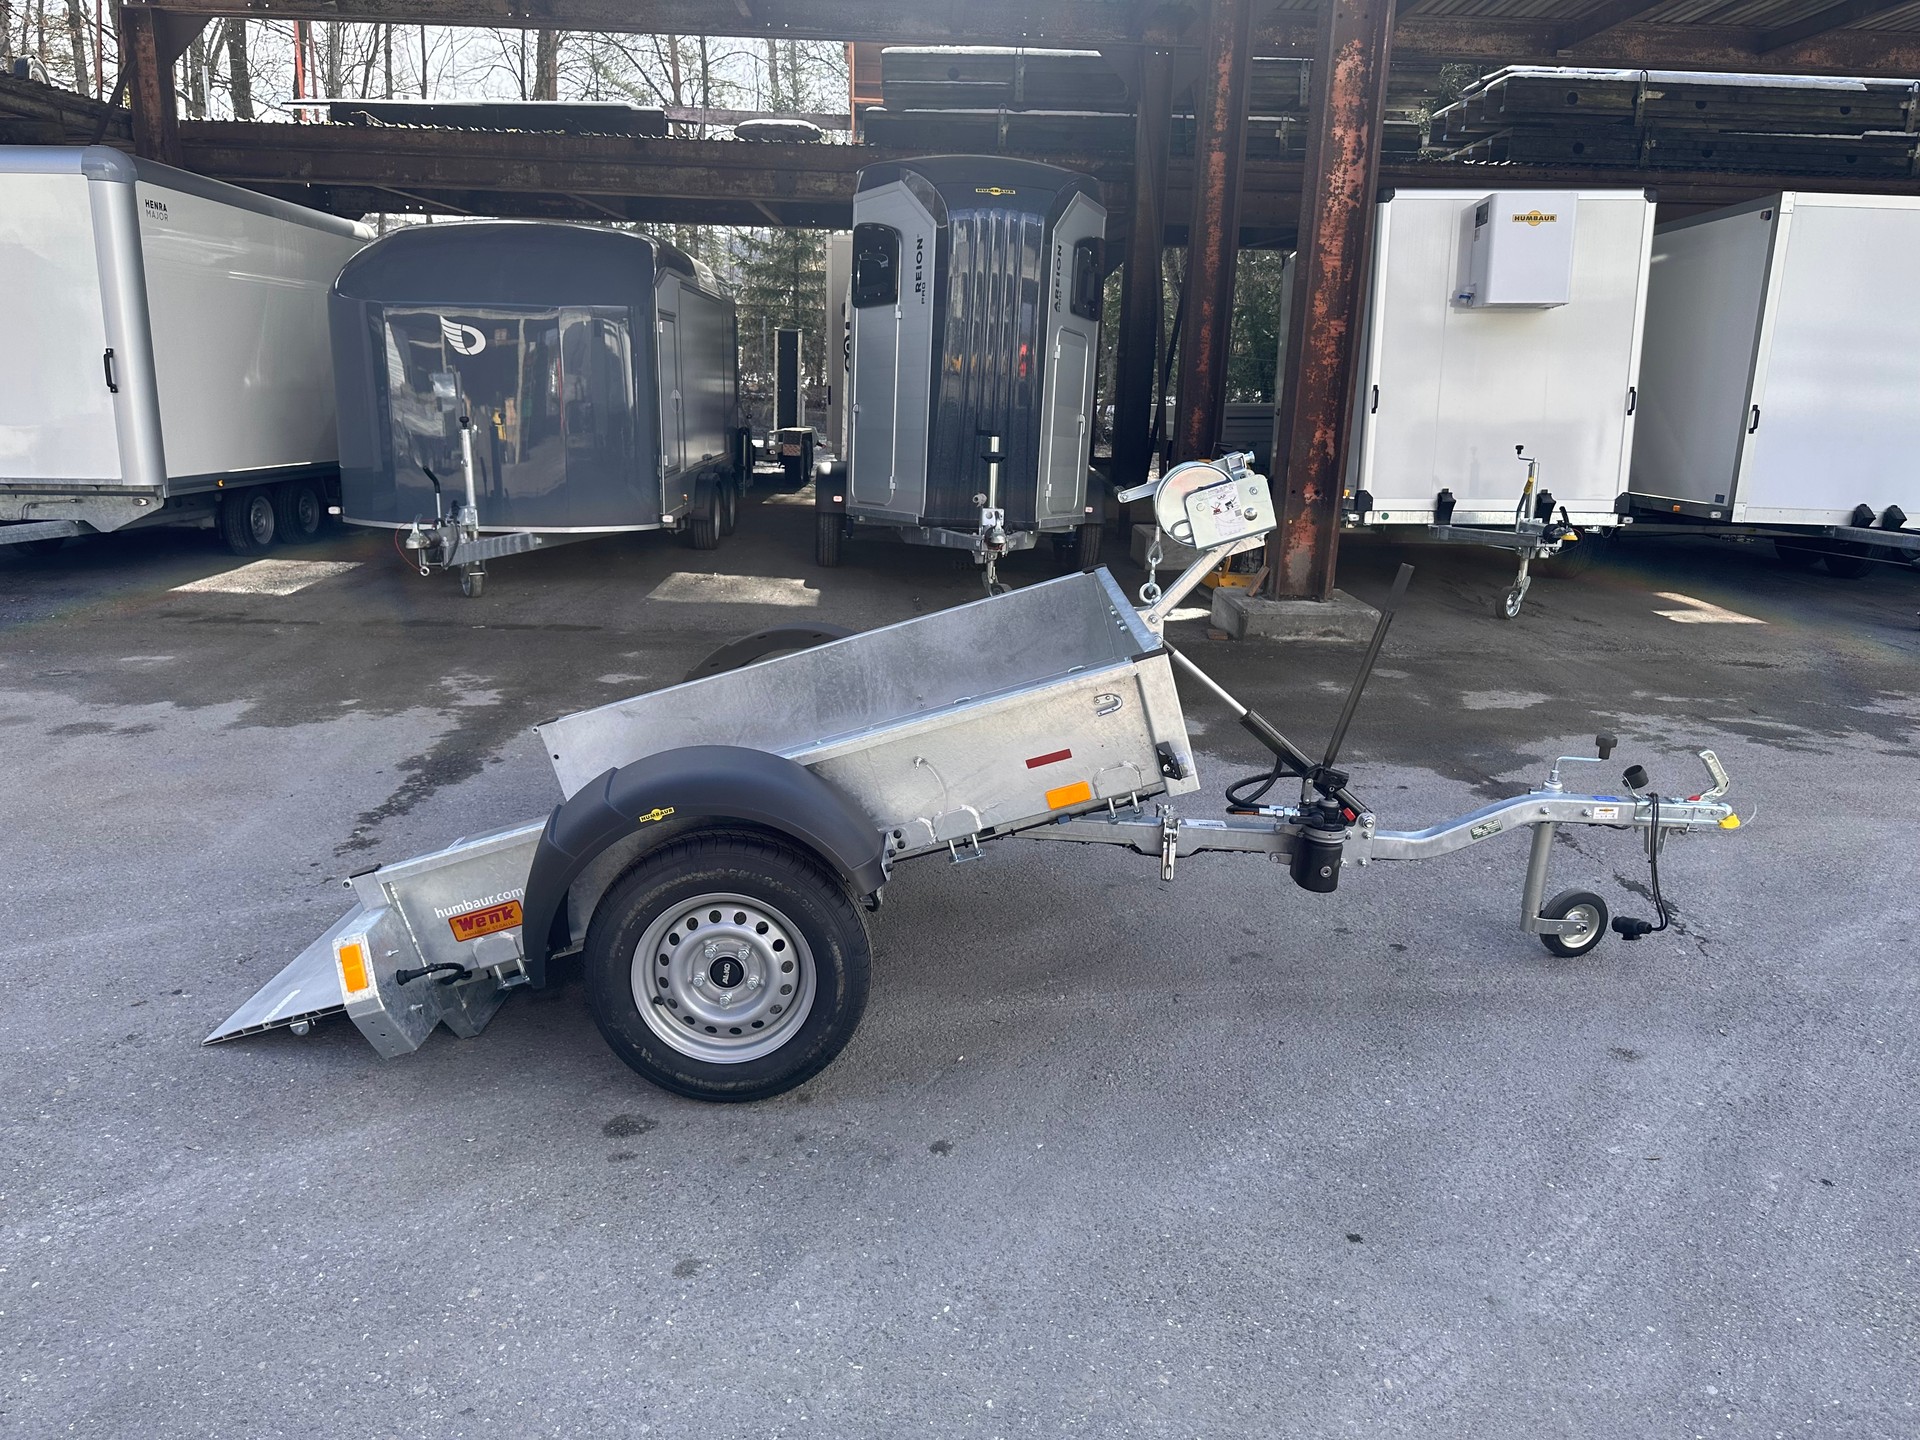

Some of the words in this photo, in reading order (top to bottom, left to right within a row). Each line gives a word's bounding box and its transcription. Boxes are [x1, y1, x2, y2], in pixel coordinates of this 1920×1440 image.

[145, 199, 168, 212] HENRA
[146, 209, 168, 221] MAJOR
[1513, 214, 1556, 222] HUMBAUR
[1054, 245, 1062, 312] AREION
[640, 808, 674, 821] HUMBAUR
[434, 888, 524, 918] humbaur.com
[456, 906, 514, 932] Wenk
